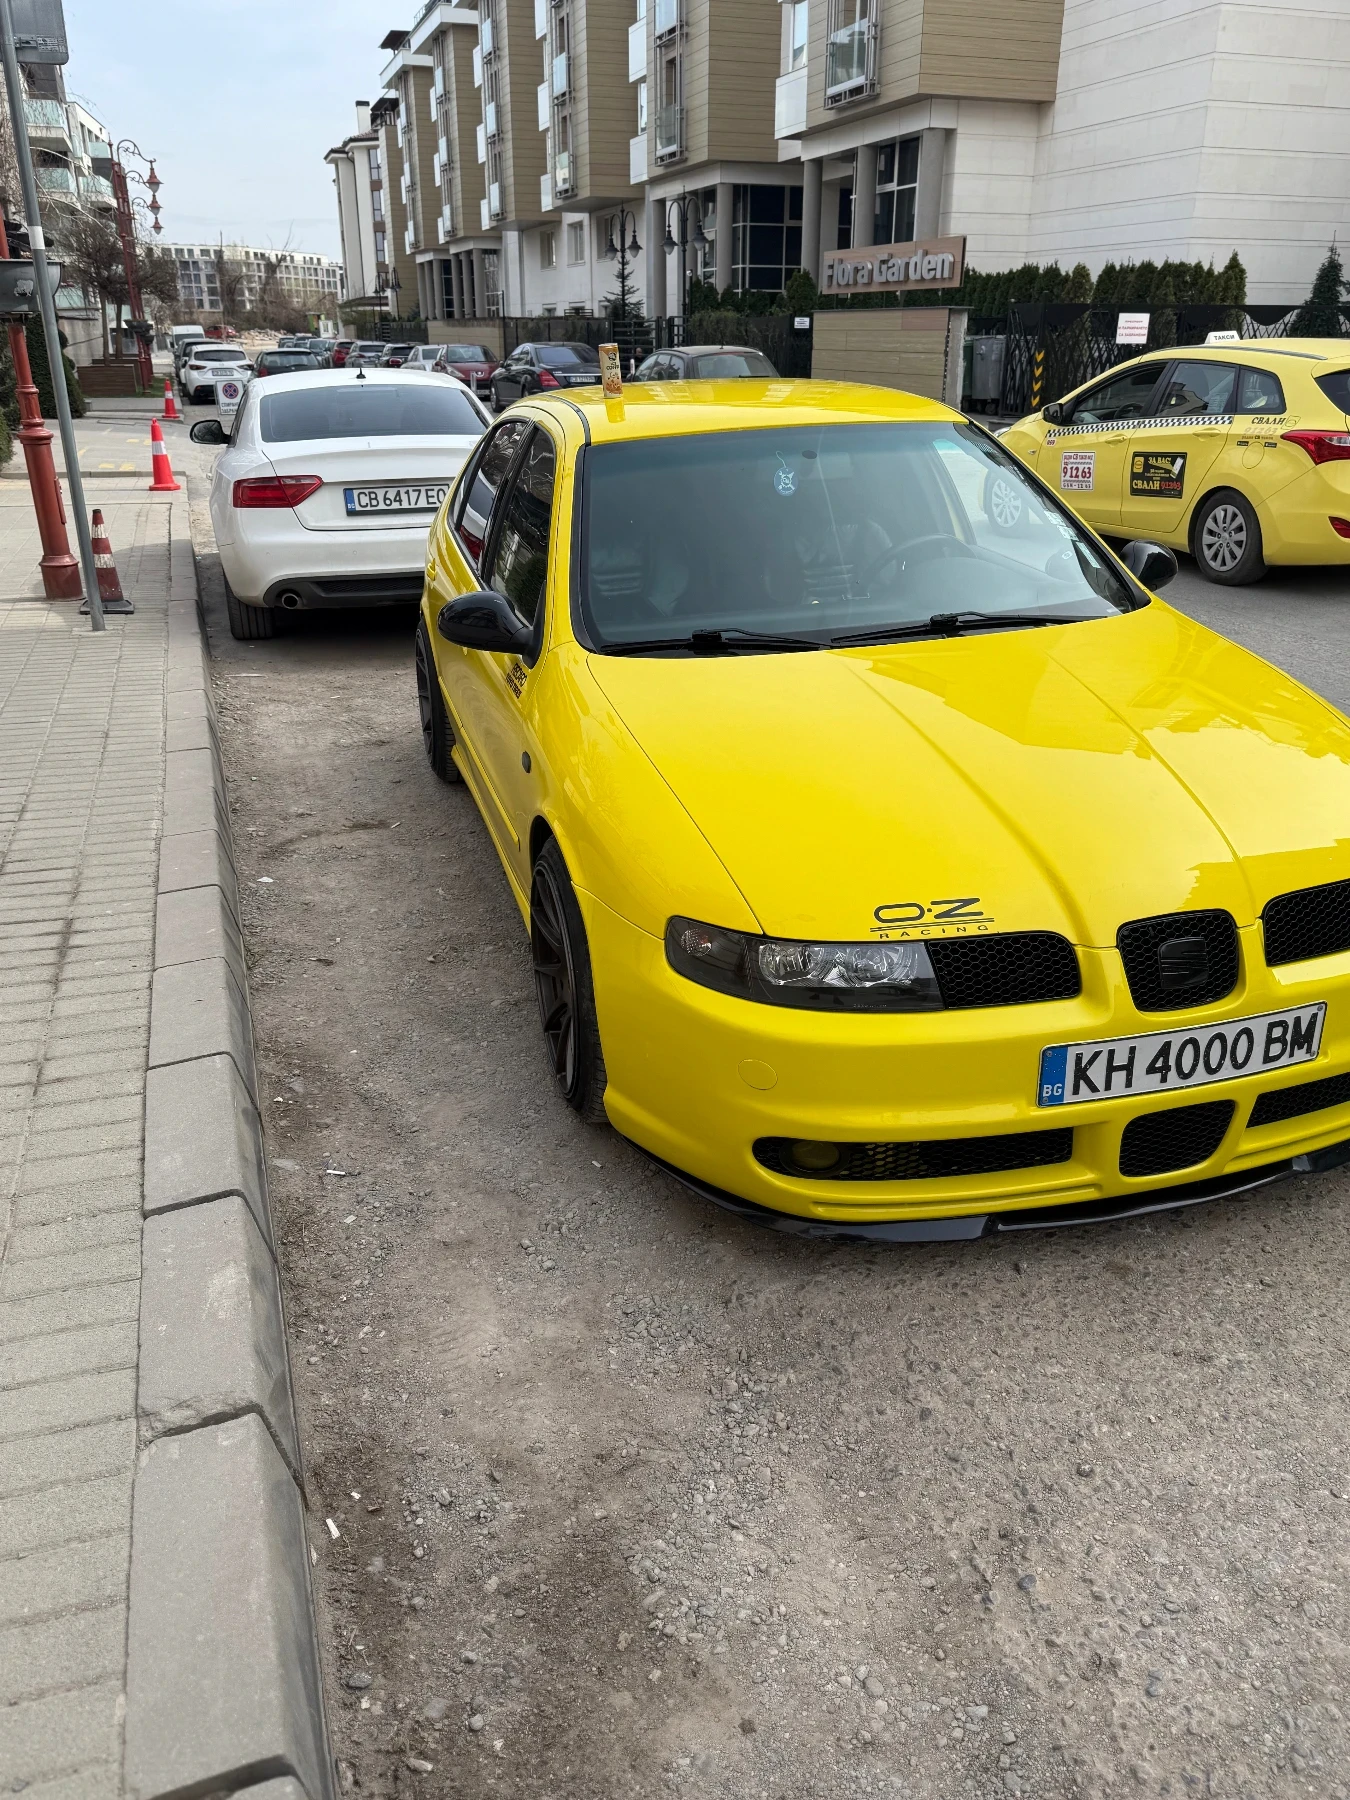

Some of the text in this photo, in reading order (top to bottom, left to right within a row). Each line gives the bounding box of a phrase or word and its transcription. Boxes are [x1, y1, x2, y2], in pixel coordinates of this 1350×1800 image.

[823, 249, 955, 287] Flora Garden
[357, 490, 379, 508] CB
[383, 488, 421, 507] 6417
[879, 924, 989, 939] RACING
[1072, 1012, 1319, 1096] KH 4000 BM
[1042, 1083, 1063, 1098] BG
